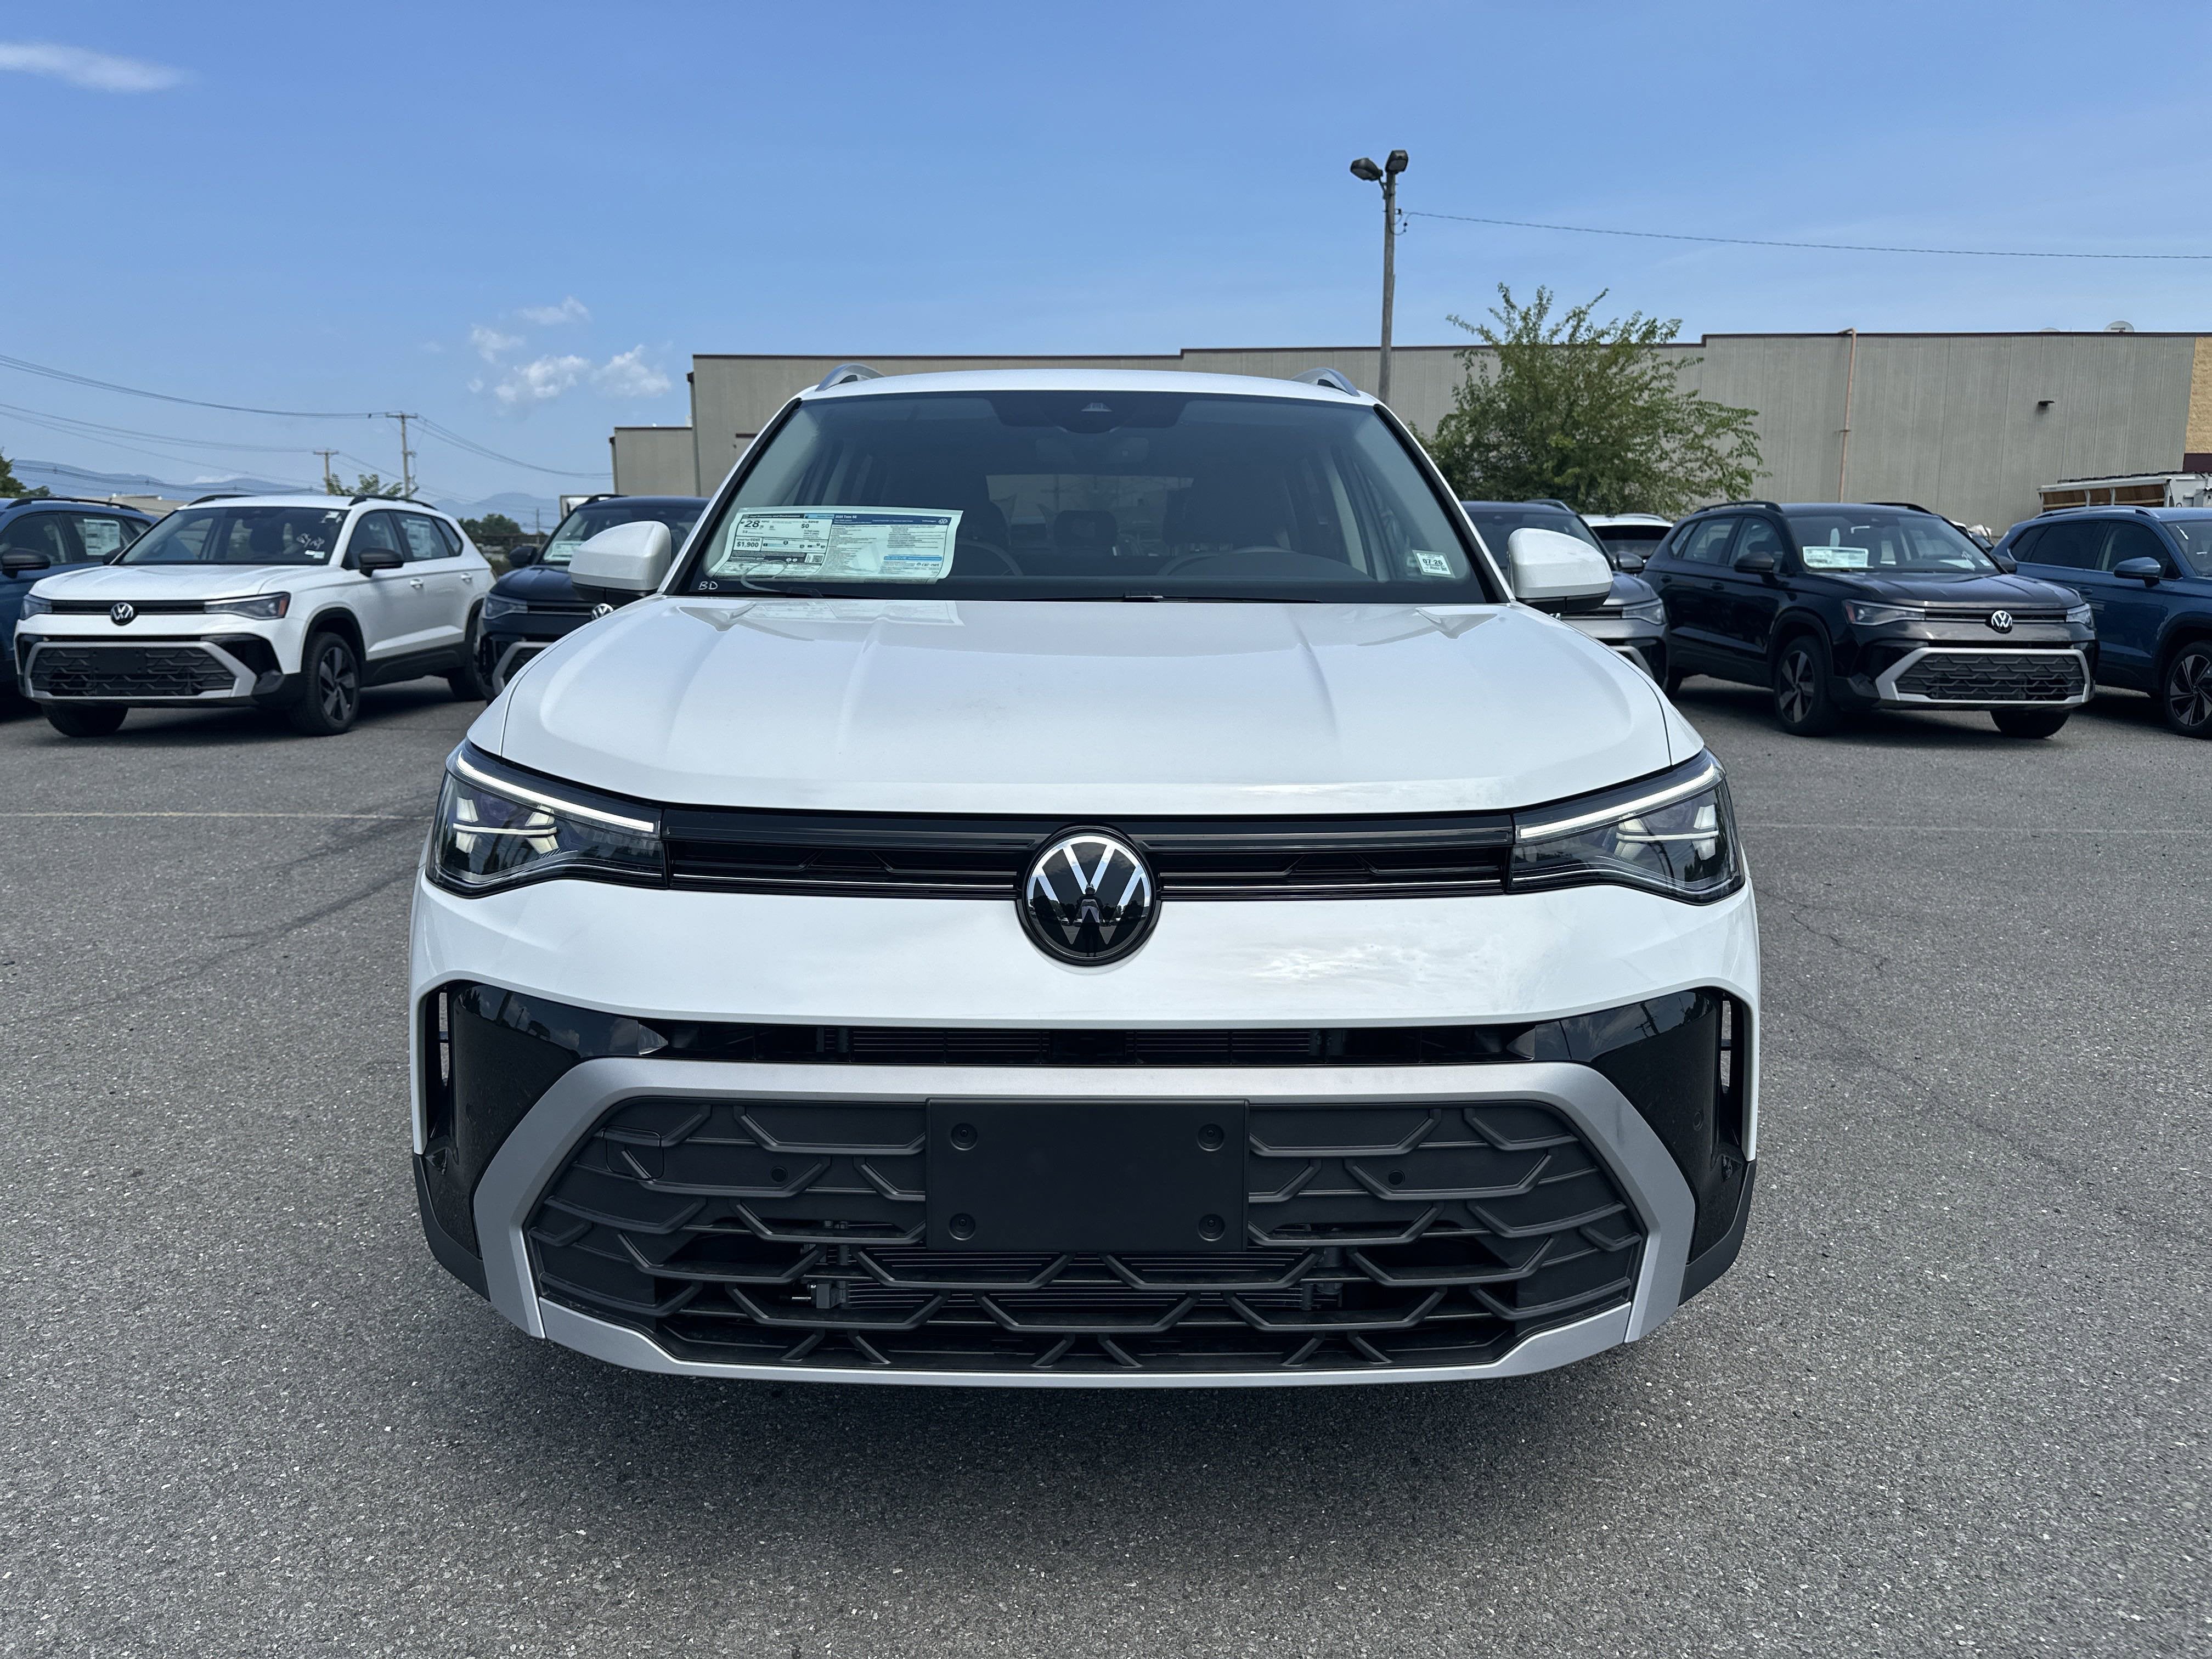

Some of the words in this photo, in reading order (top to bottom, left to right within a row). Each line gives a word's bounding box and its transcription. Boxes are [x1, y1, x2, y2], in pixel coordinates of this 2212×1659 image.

[698, 581, 718, 590] BD
[1991, 610, 2012, 629] VW
[1029, 838, 1149, 953] VW
